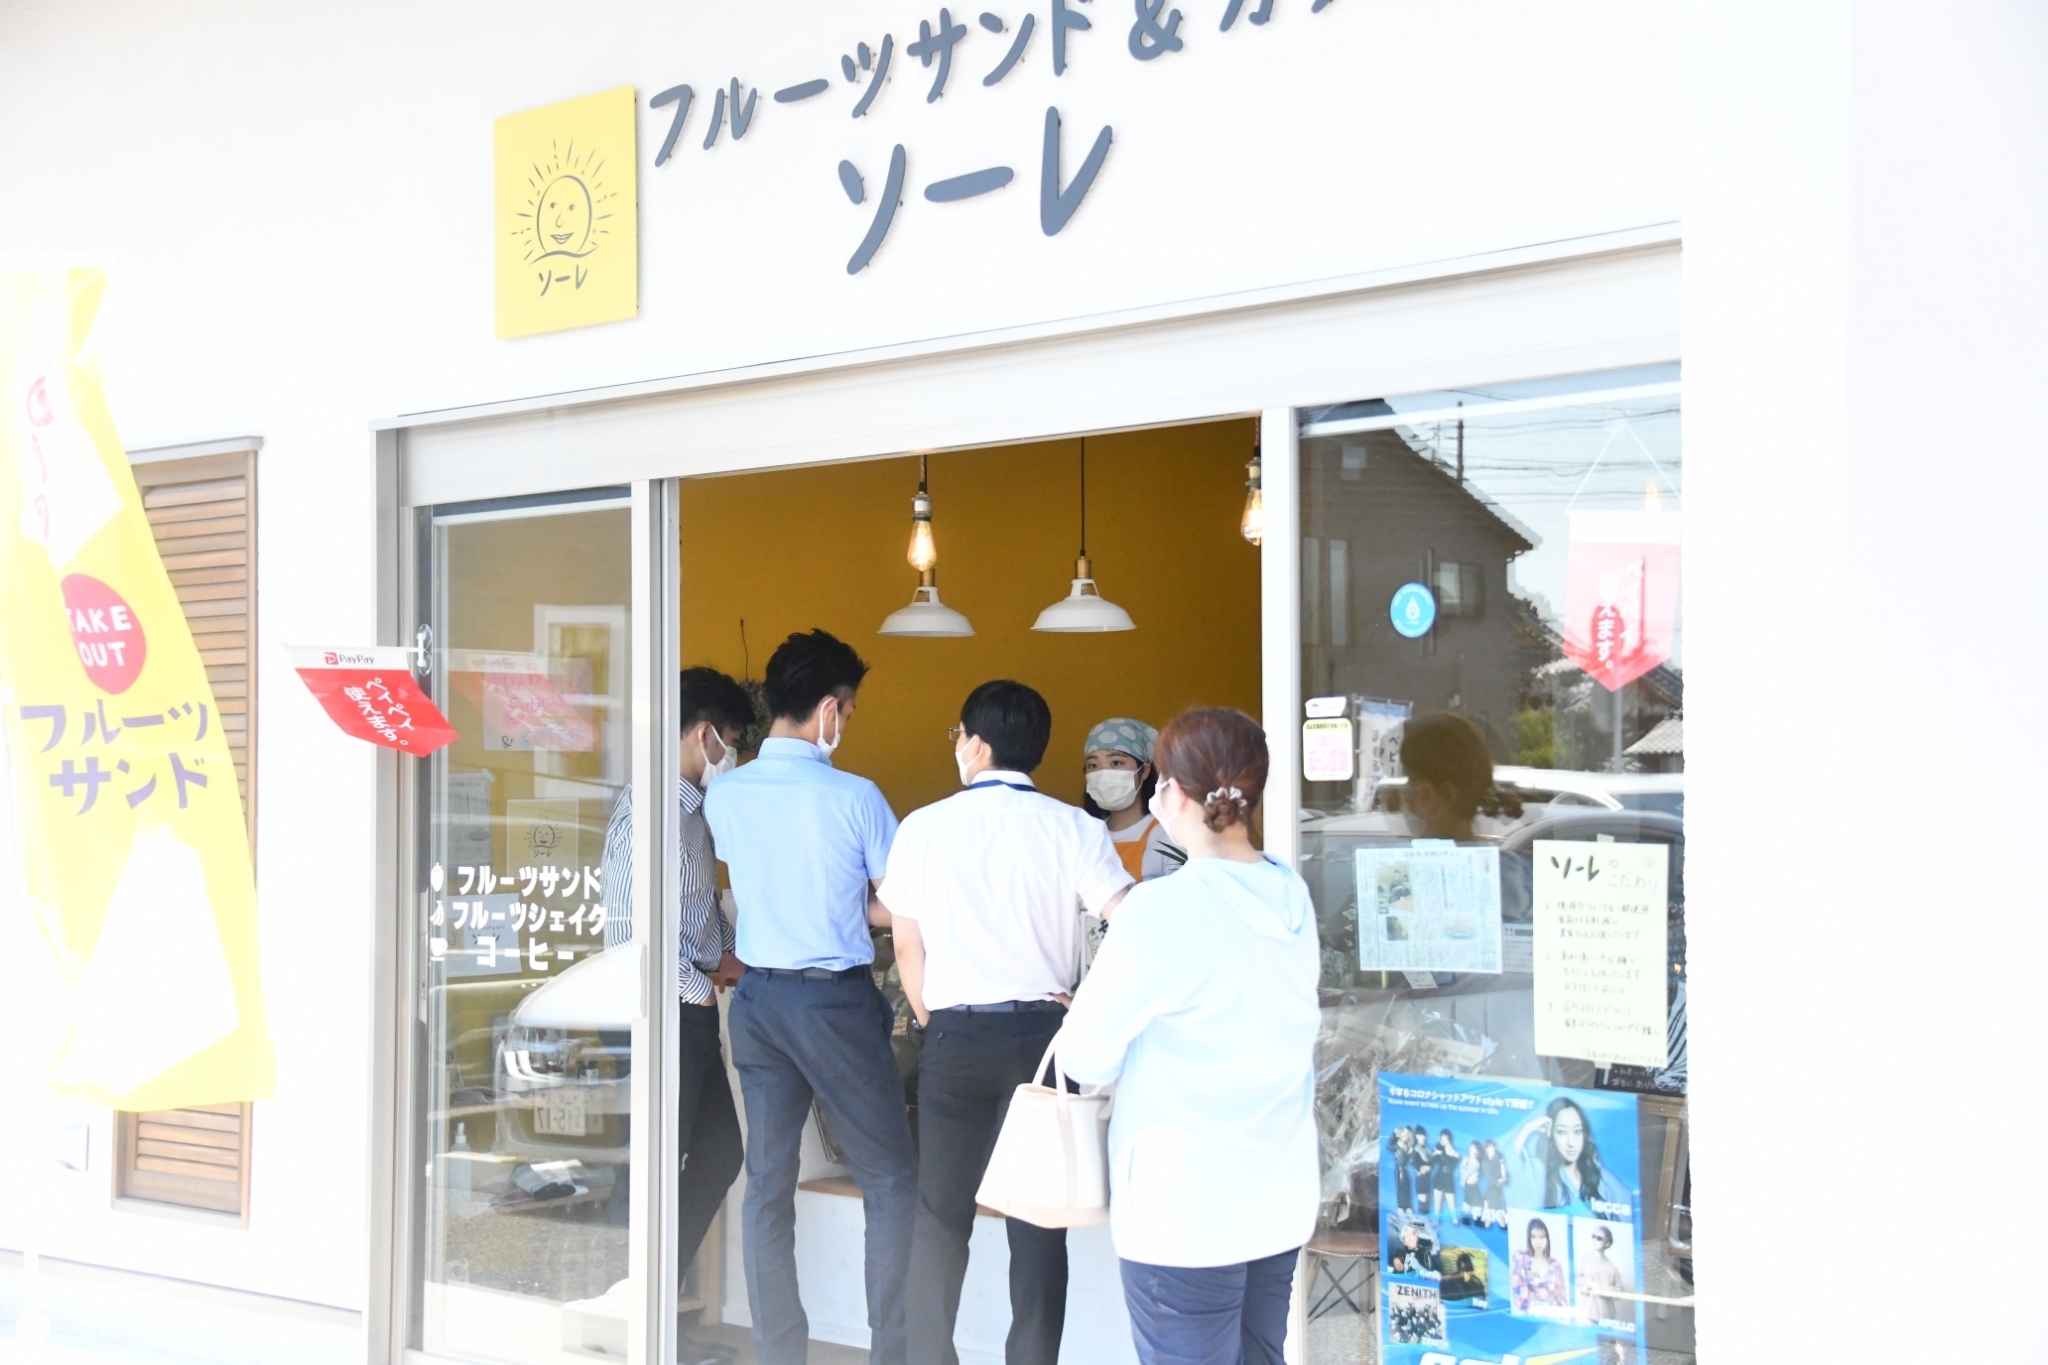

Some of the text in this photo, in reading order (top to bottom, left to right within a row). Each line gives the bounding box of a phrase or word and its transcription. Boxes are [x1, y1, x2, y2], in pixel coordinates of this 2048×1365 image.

[838, 106, 1113, 276] ソーレ
[539, 264, 588, 297] ソーレ
[78, 641, 126, 667] OUT
[339, 653, 375, 666] PayPay
[366, 676, 416, 732] ペイペイ
[19, 698, 208, 754] フルーツ
[49, 752, 208, 817] サンド
[457, 865, 602, 900] フルーツサンド
[452, 901, 608, 936] フルーツシェイク
[476, 936, 574, 971] コーヒー
[1590, 1196, 1632, 1217] lecca
[1396, 1285, 1437, 1300] ZENITH
[1598, 1317, 1636, 1333] APOLLO
